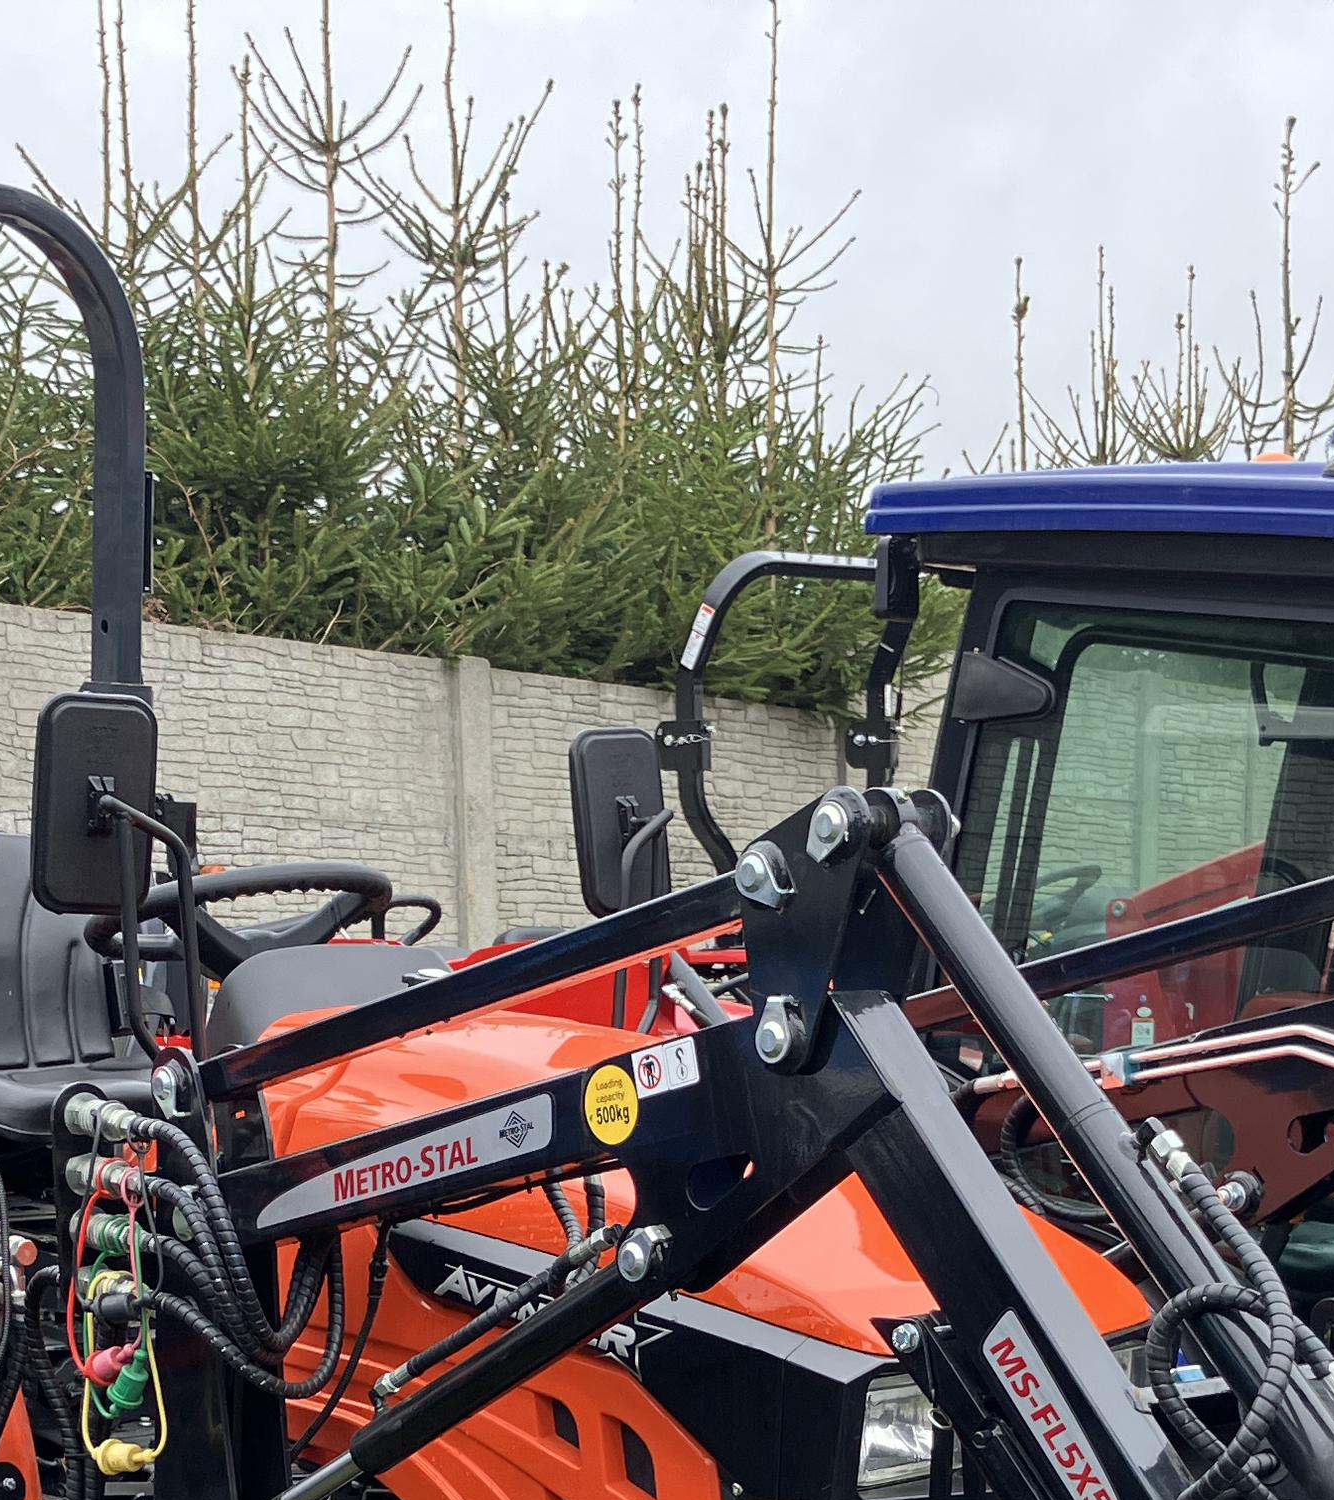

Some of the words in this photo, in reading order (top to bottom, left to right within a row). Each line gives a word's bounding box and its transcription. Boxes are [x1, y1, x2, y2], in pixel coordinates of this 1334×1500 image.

[595, 1079, 623, 1091] Loading
[595, 1091, 625, 1105] capacity
[595, 1104, 630, 1126] 500kg
[333, 1136, 478, 1202] METRO-STAL
